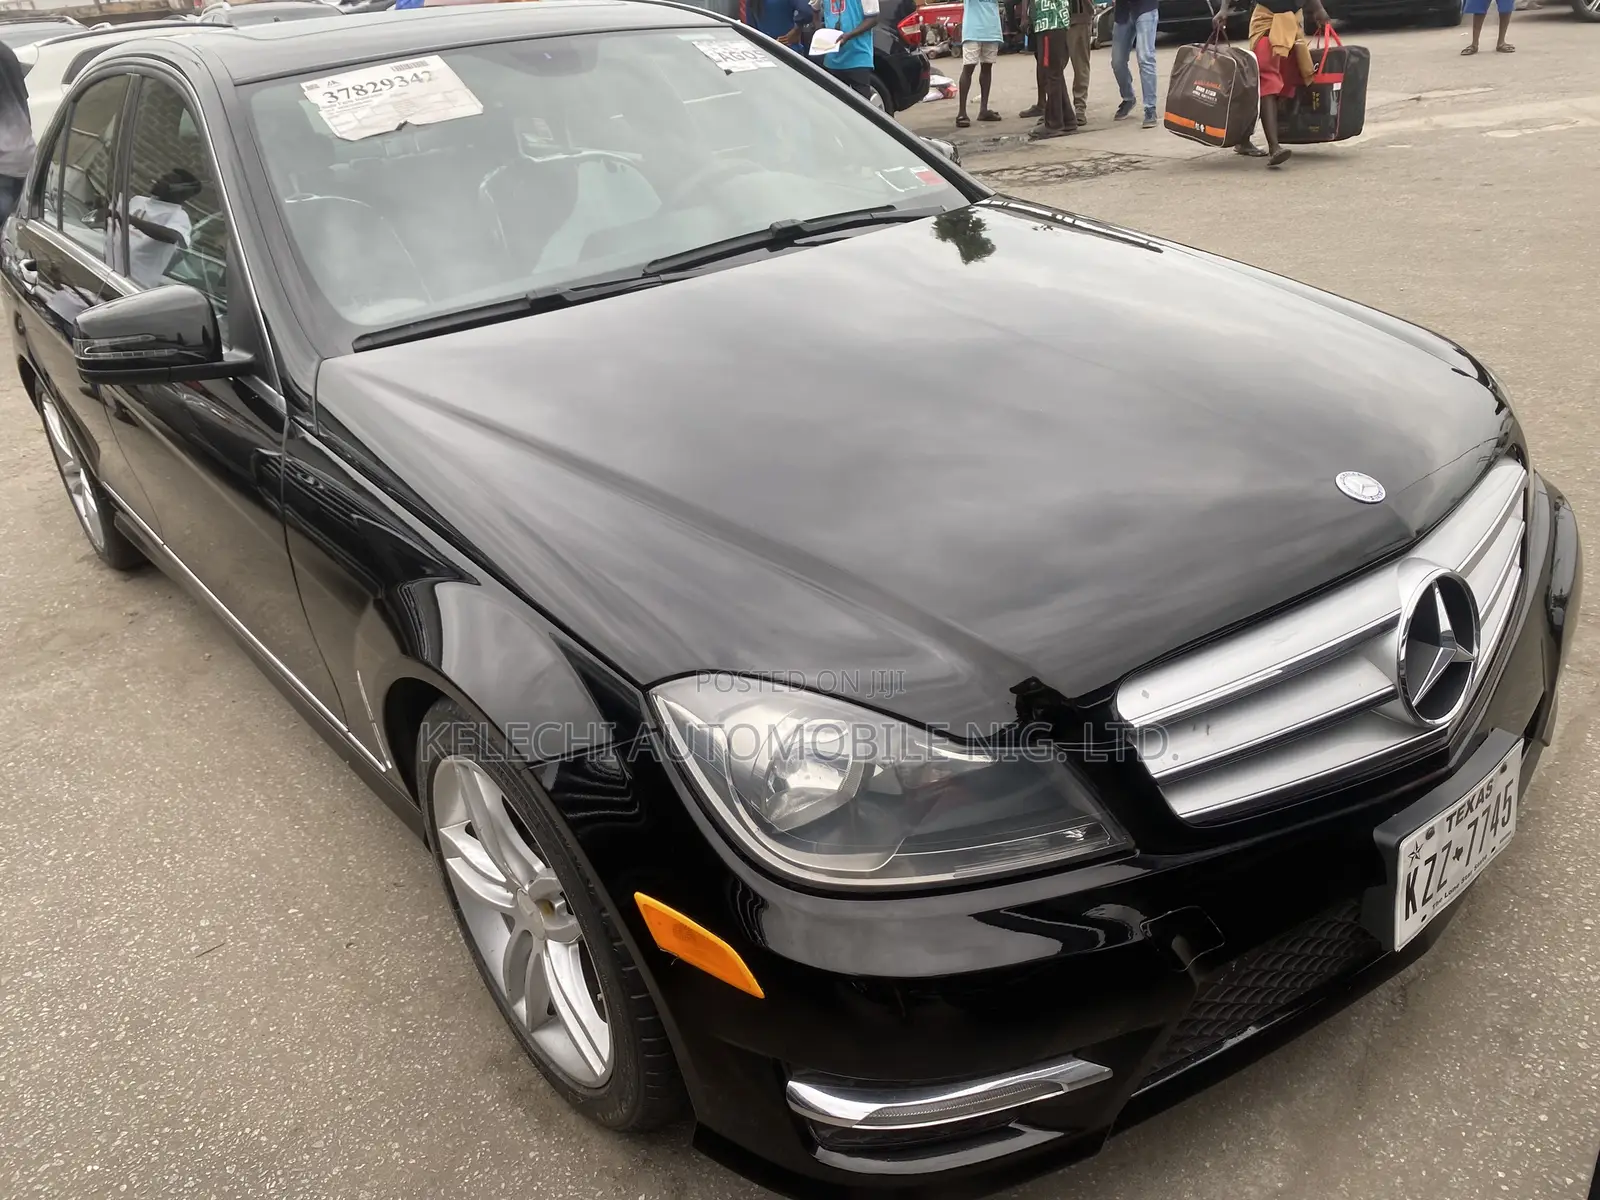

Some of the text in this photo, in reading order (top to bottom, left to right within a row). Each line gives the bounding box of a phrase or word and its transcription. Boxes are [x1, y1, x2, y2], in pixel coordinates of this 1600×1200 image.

[322, 70, 437, 104] 37829342
[1446, 777, 1494, 833] TEXAS
[1465, 778, 1515, 868] 7745
